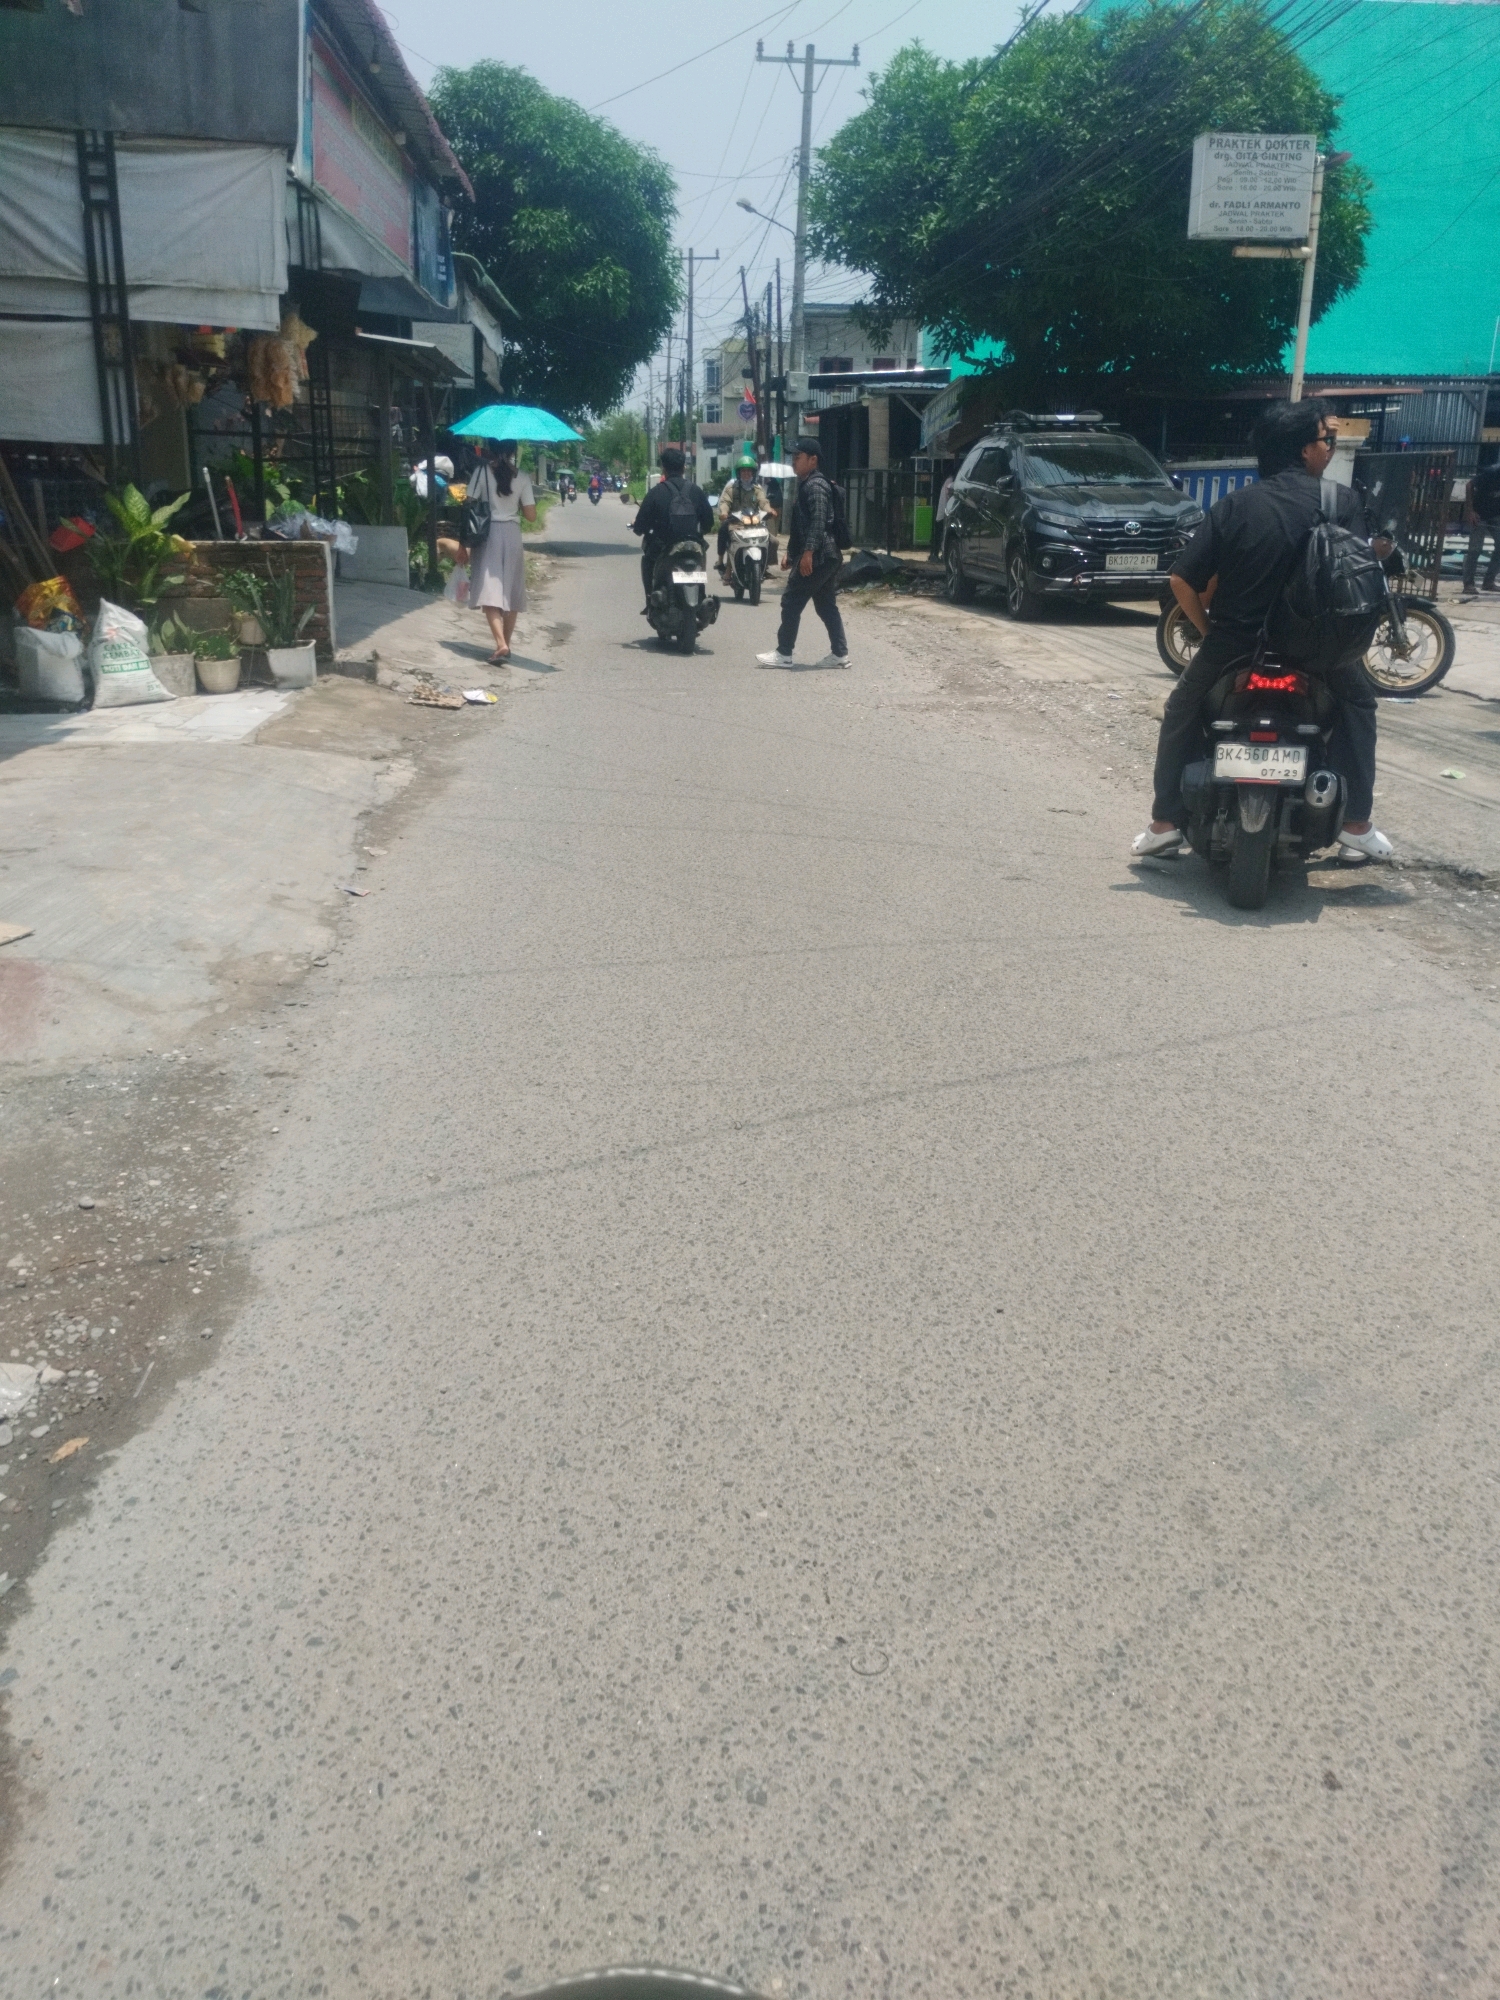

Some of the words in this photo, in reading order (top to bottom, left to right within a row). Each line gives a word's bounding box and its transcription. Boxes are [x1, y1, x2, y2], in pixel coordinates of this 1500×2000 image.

[1209, 138, 1261, 149] PRAKTEK
[1265, 139, 1310, 150] DOKTER
[1214, 152, 1232, 161] drg.
[1236, 152, 1259, 160] GITA
[1261, 152, 1302, 161] GINTING
[1209, 201, 1221, 209] dr.
[1223, 201, 1251, 209] FADLI
[1253, 201, 1301, 210] ARMANTO
